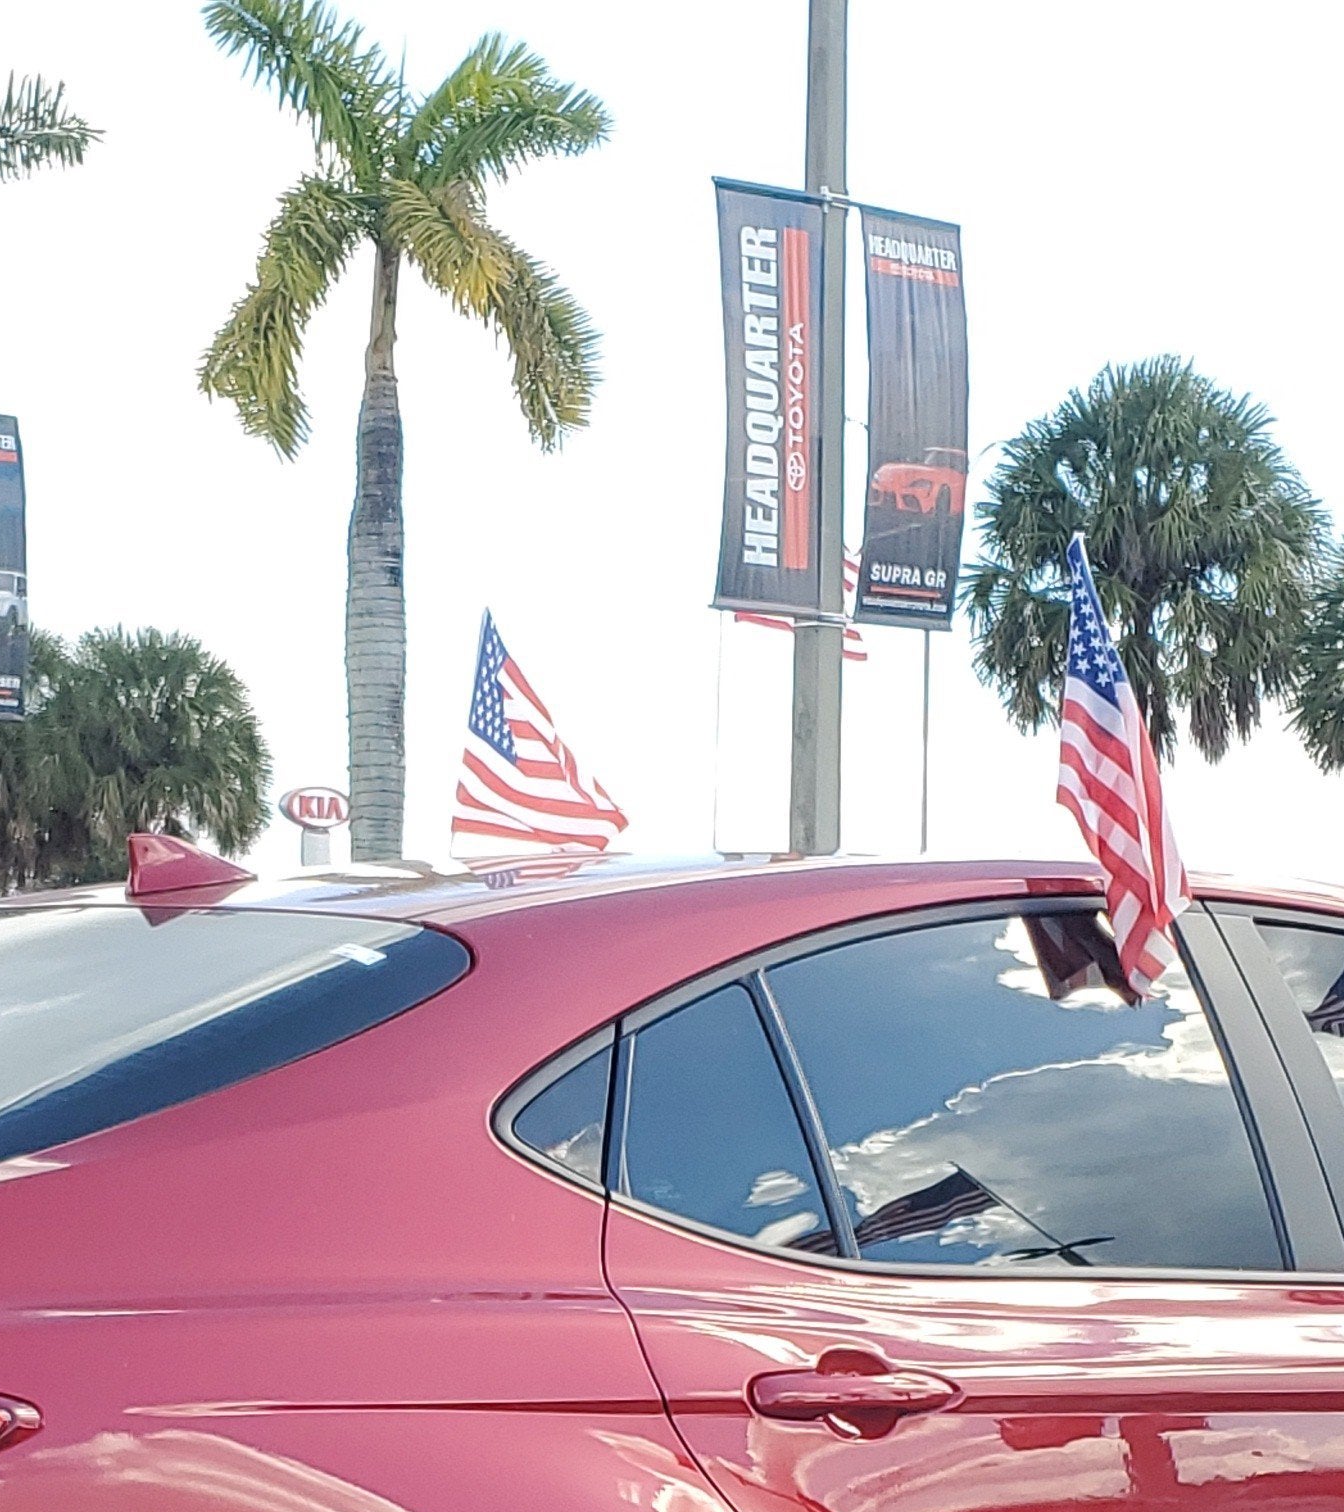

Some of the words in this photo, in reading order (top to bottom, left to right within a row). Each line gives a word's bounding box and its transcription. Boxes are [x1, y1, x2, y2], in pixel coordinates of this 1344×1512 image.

[868, 233, 957, 271] HEADQUARTER
[739, 225, 783, 568] HEADQUARTER
[788, 322, 804, 446] TOYOTA
[870, 562, 921, 587] SUPRA
[924, 567, 947, 590] GR
[298, 795, 344, 820] KIA
